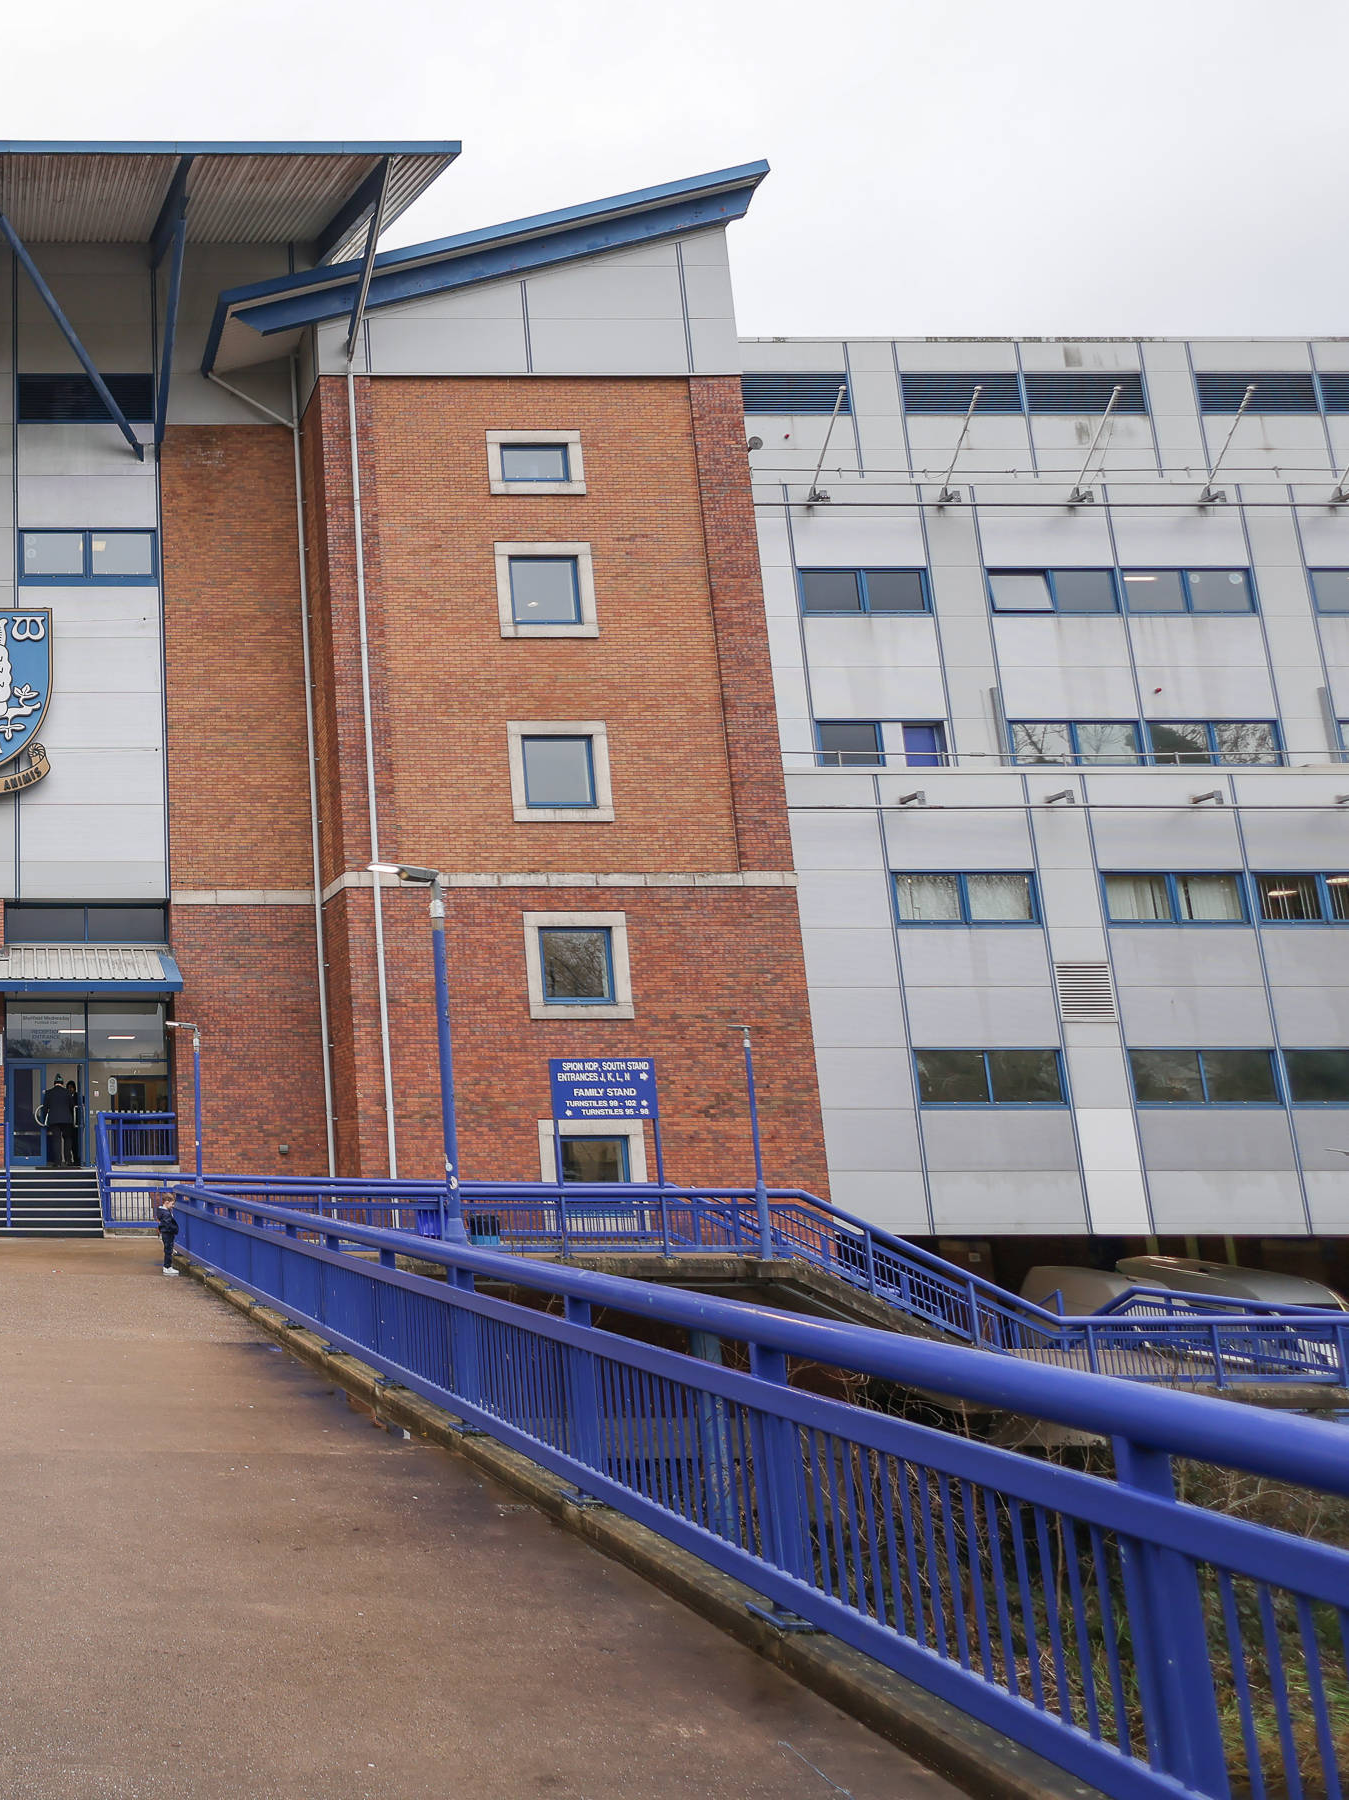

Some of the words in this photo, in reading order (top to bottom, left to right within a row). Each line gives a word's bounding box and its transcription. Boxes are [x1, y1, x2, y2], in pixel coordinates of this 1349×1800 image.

[3, 766, 42, 791] ANIMIS
[562, 1061, 583, 1071] SPION
[584, 1062, 601, 1071] KOP,
[601, 1061, 626, 1070] SOUTH
[627, 1061, 649, 1070] STAND
[557, 1072, 598, 1081] ENTRANCES
[599, 1073, 606, 1082] J,
[607, 1073, 615, 1082] K,
[616, 1073, 624, 1082] L,
[573, 1088, 604, 1096] FAMILY
[606, 1088, 637, 1096] STAND
